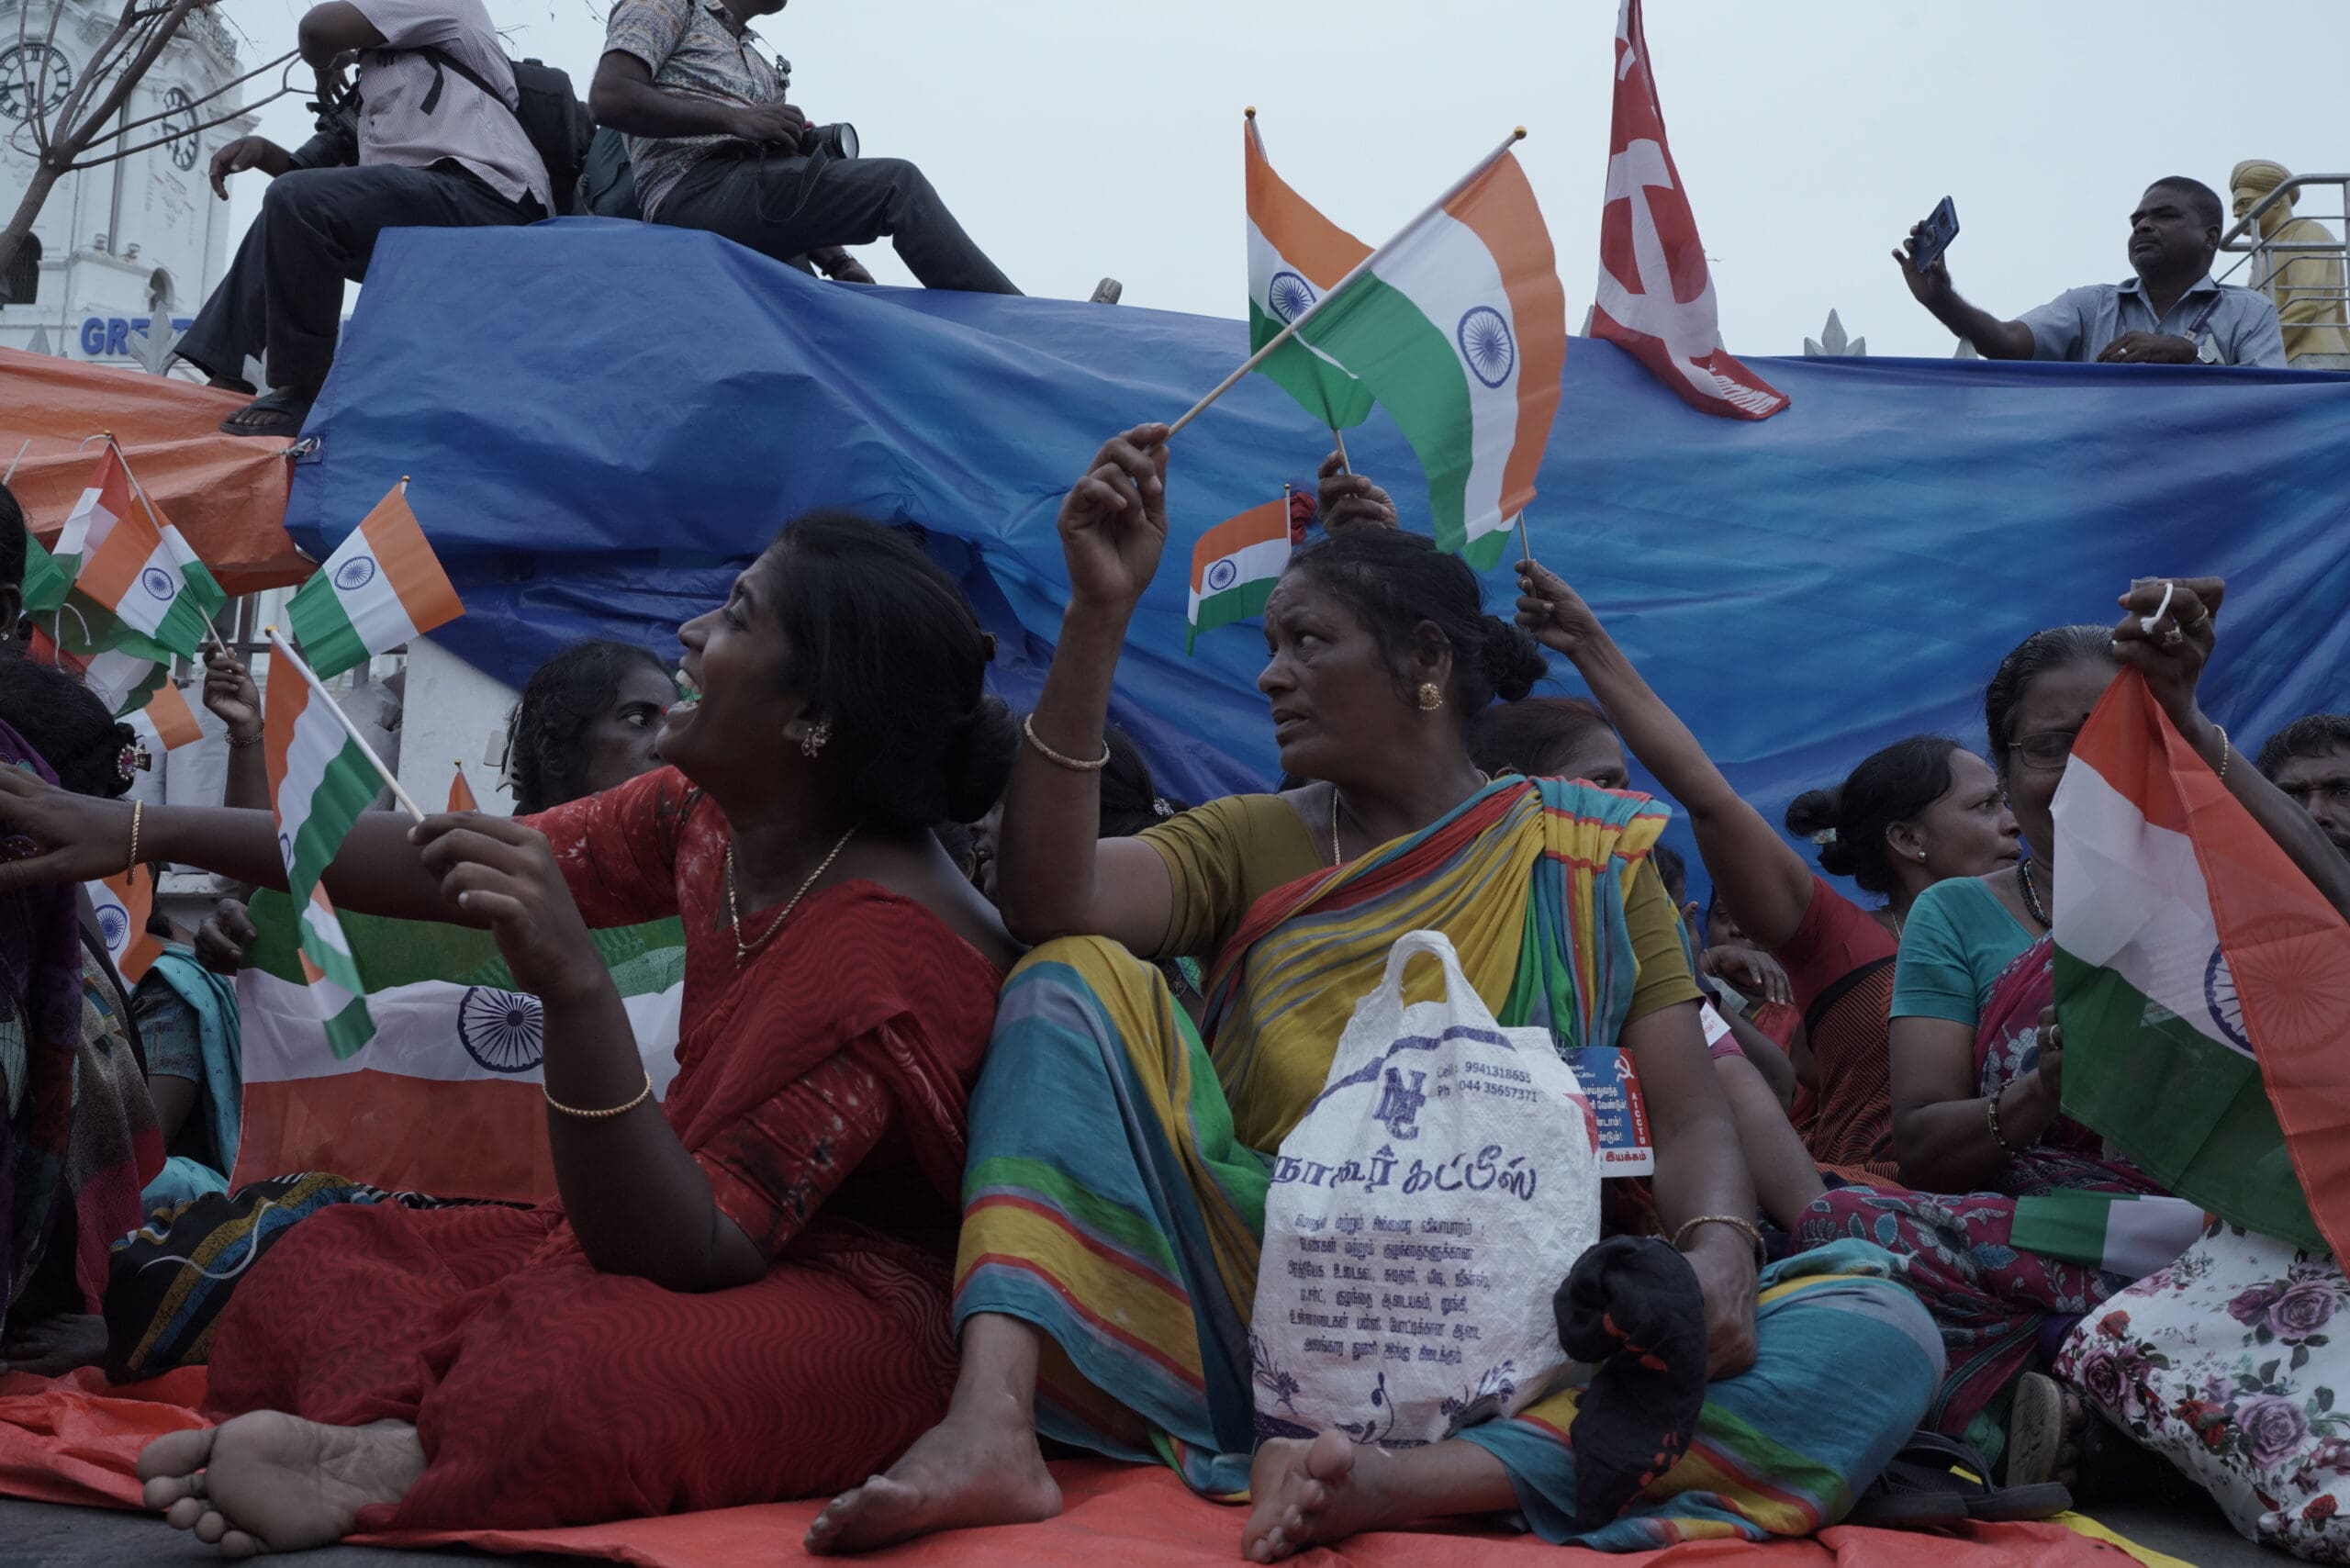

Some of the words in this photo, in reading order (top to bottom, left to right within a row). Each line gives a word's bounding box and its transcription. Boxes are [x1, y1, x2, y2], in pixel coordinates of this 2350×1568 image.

[1465, 1061, 1532, 1083] 9941318655
[1438, 1084, 1450, 1097] Ph
[1483, 1081, 1538, 1102] 35657371
[1631, 1092, 1646, 1145] AICCTU
[1606, 1150, 1646, 1162] இயக்கம்
[1402, 1145, 1537, 1201] கட்பீஸ்
[1345, 1238, 1375, 1260] மற்றும்
[1336, 1286, 1372, 1308] குழந்தை
